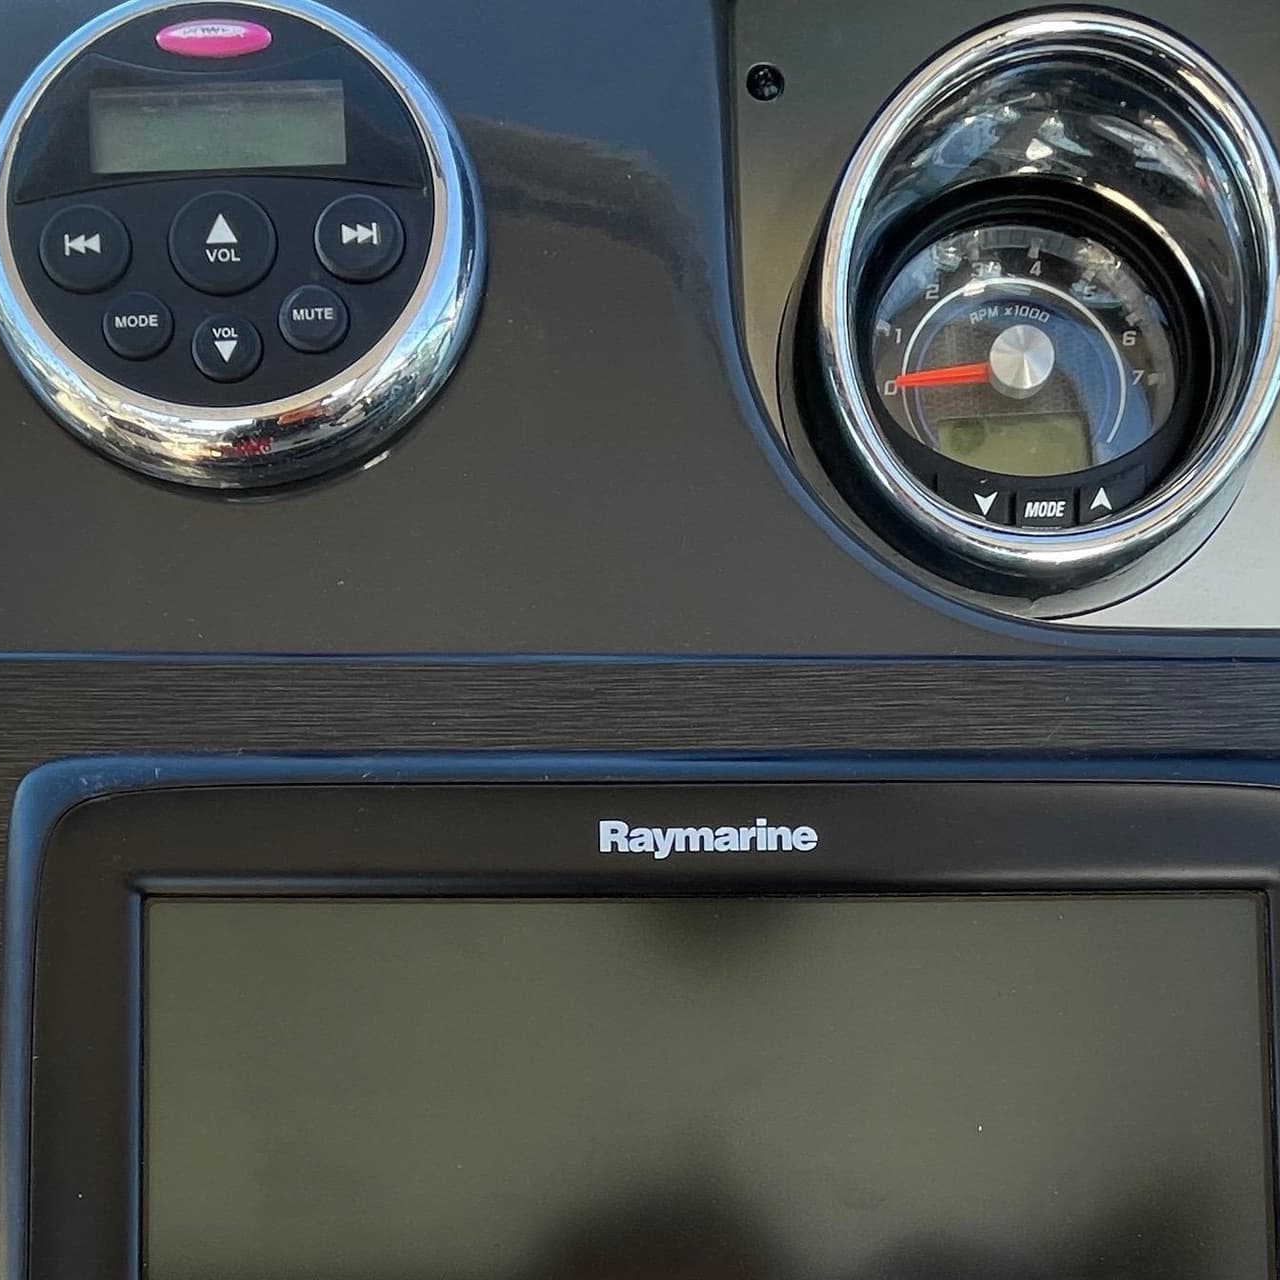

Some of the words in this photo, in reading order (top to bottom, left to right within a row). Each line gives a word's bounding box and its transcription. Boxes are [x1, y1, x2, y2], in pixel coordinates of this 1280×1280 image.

[205, 248, 240, 263] VOL
[1030, 260, 1042, 277] 4
[925, 283, 940, 300] 2
[115, 314, 158, 329] MODE
[292, 308, 334, 322] MUTE
[970, 306, 999, 325] RPM
[212, 327, 238, 339] VOL
[894, 327, 903, 345] 1
[1122, 330, 1136, 347] 6
[1131, 369, 1145, 386] 7
[1024, 500, 1066, 519] MODE
[599, 818, 818, 860] Raymarine
